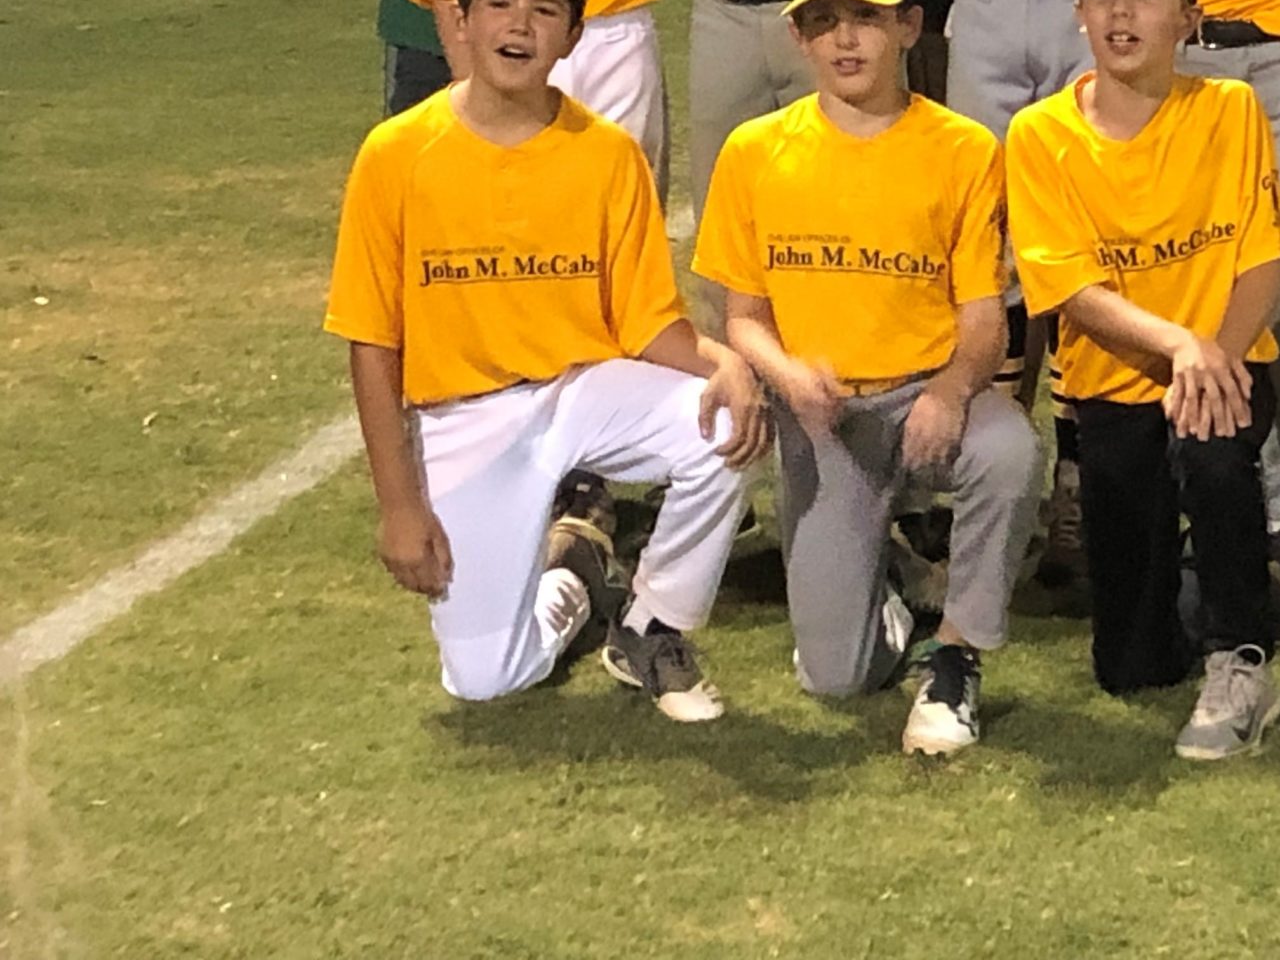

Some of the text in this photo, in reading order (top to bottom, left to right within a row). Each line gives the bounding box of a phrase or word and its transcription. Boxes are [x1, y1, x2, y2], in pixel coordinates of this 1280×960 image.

[420, 254, 598, 287] John M. McCab
[764, 245, 946, 277] John M. McCabe
